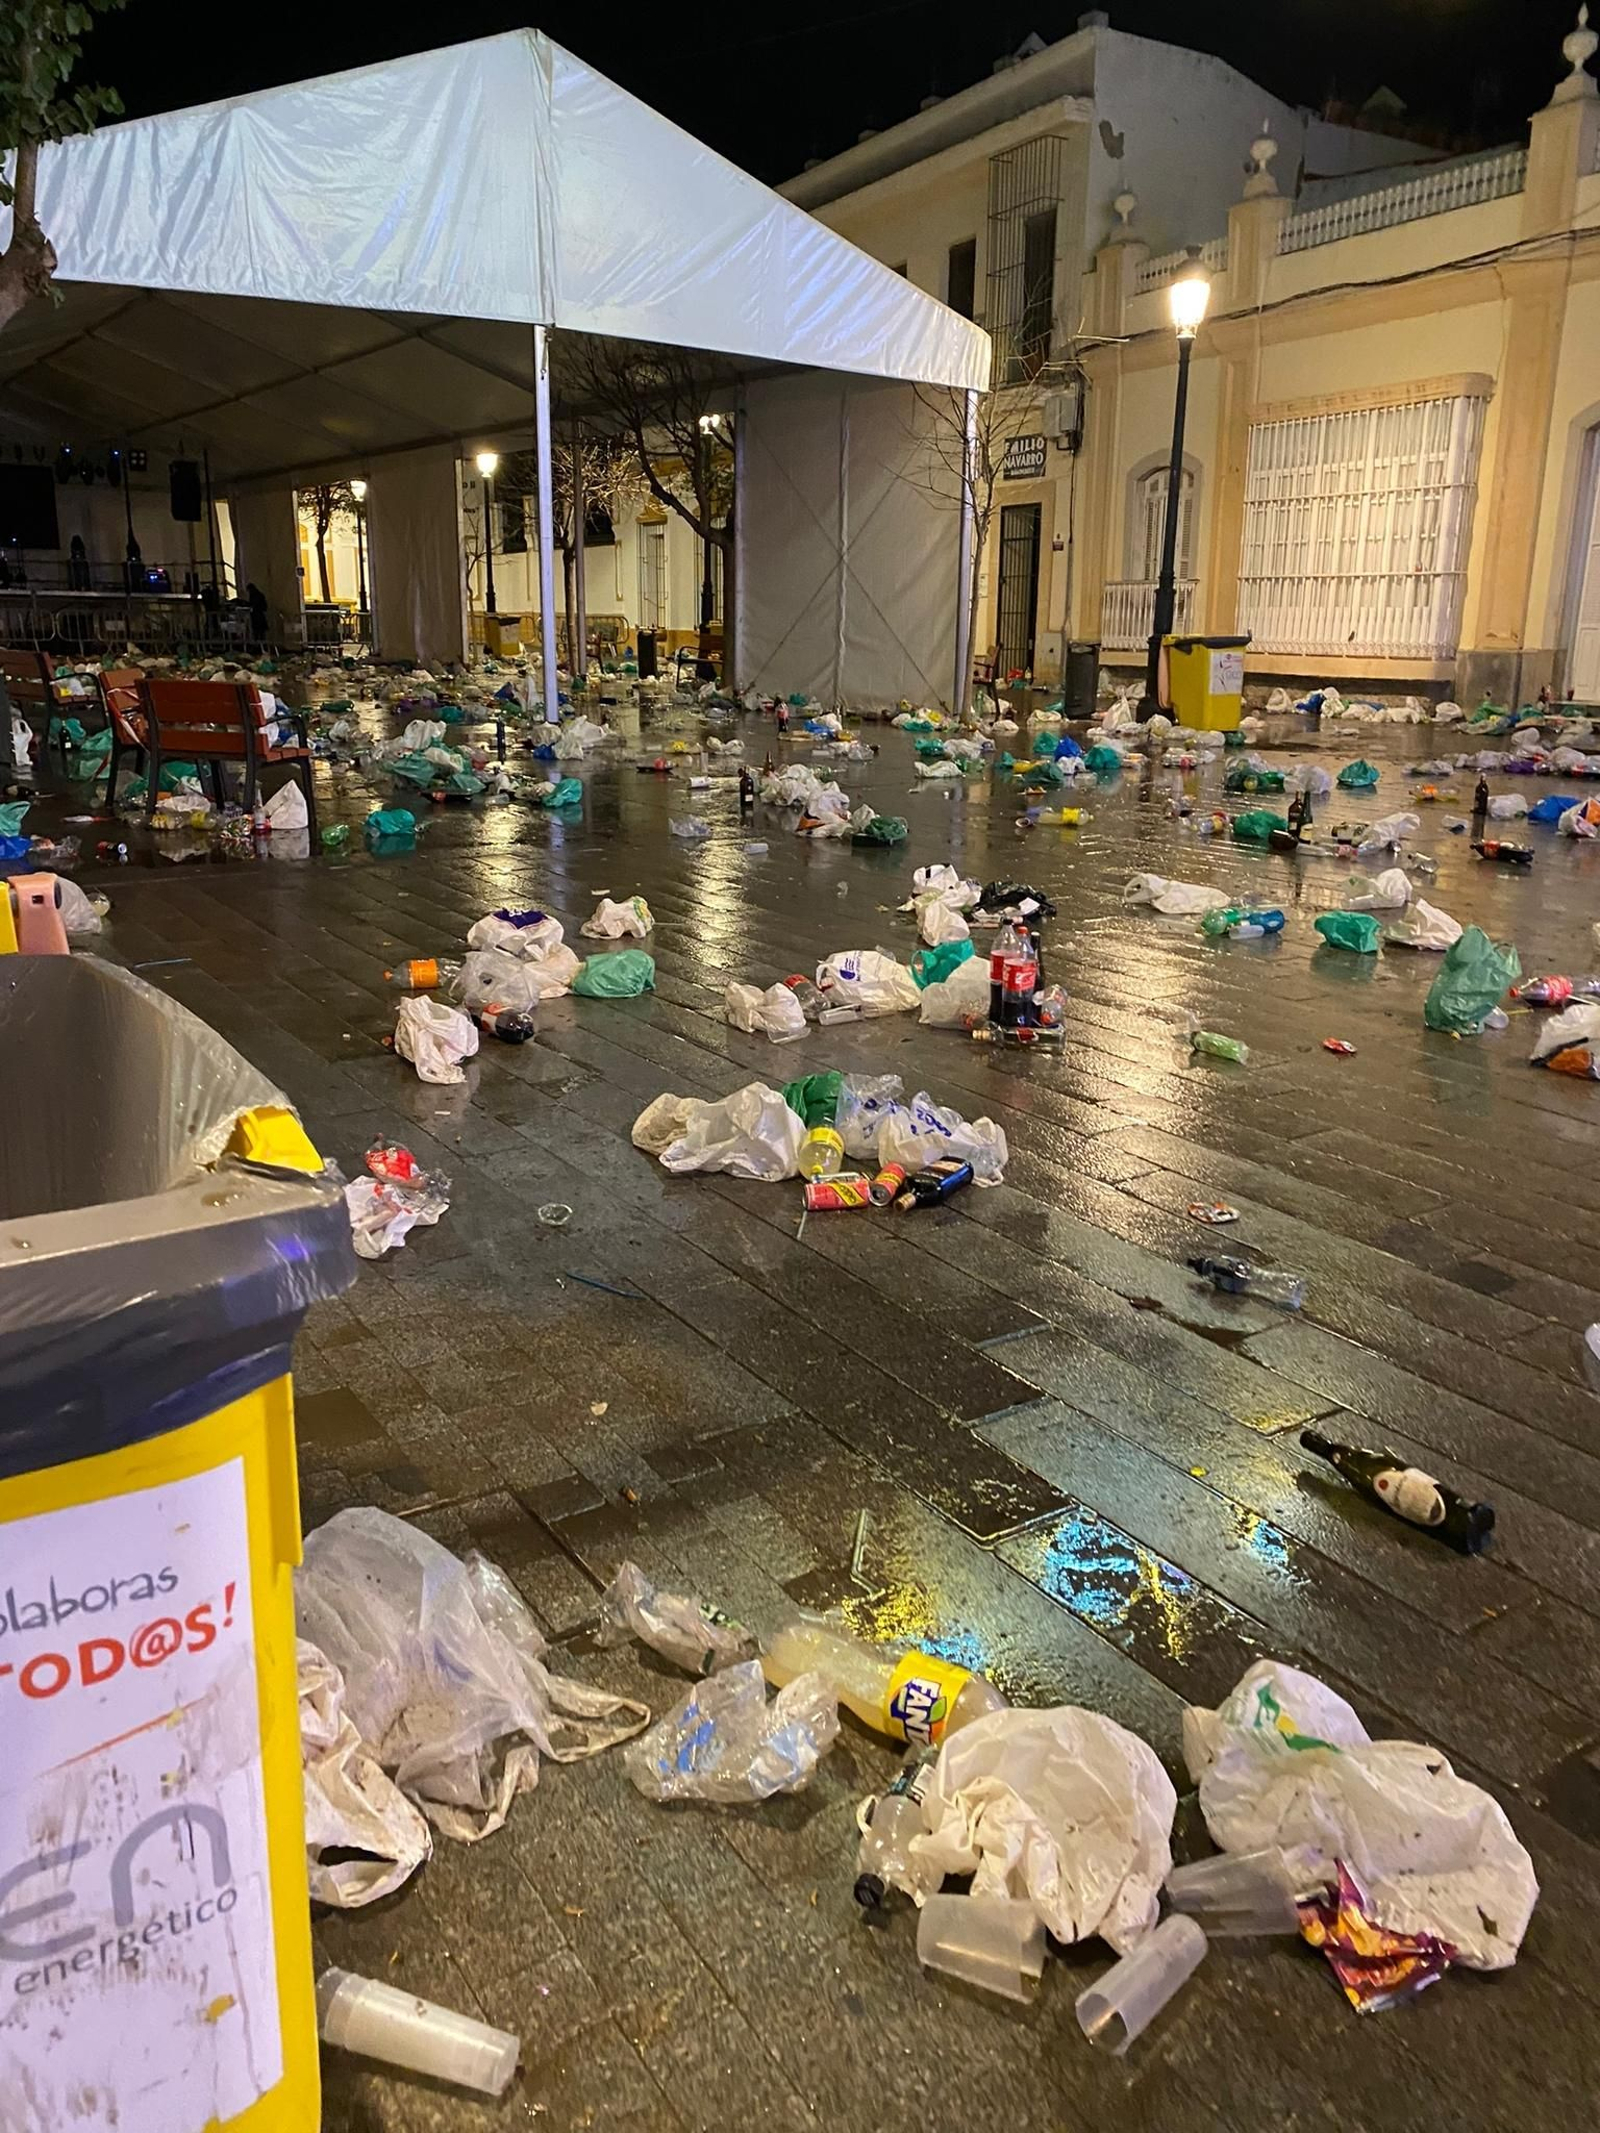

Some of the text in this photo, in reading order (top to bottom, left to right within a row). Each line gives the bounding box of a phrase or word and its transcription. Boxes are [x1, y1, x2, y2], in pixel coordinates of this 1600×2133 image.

[1005, 437, 1045, 454] EMILIO
[1004, 452, 1044, 468] NAVARRO
[14, 1888, 237, 1995] energético
